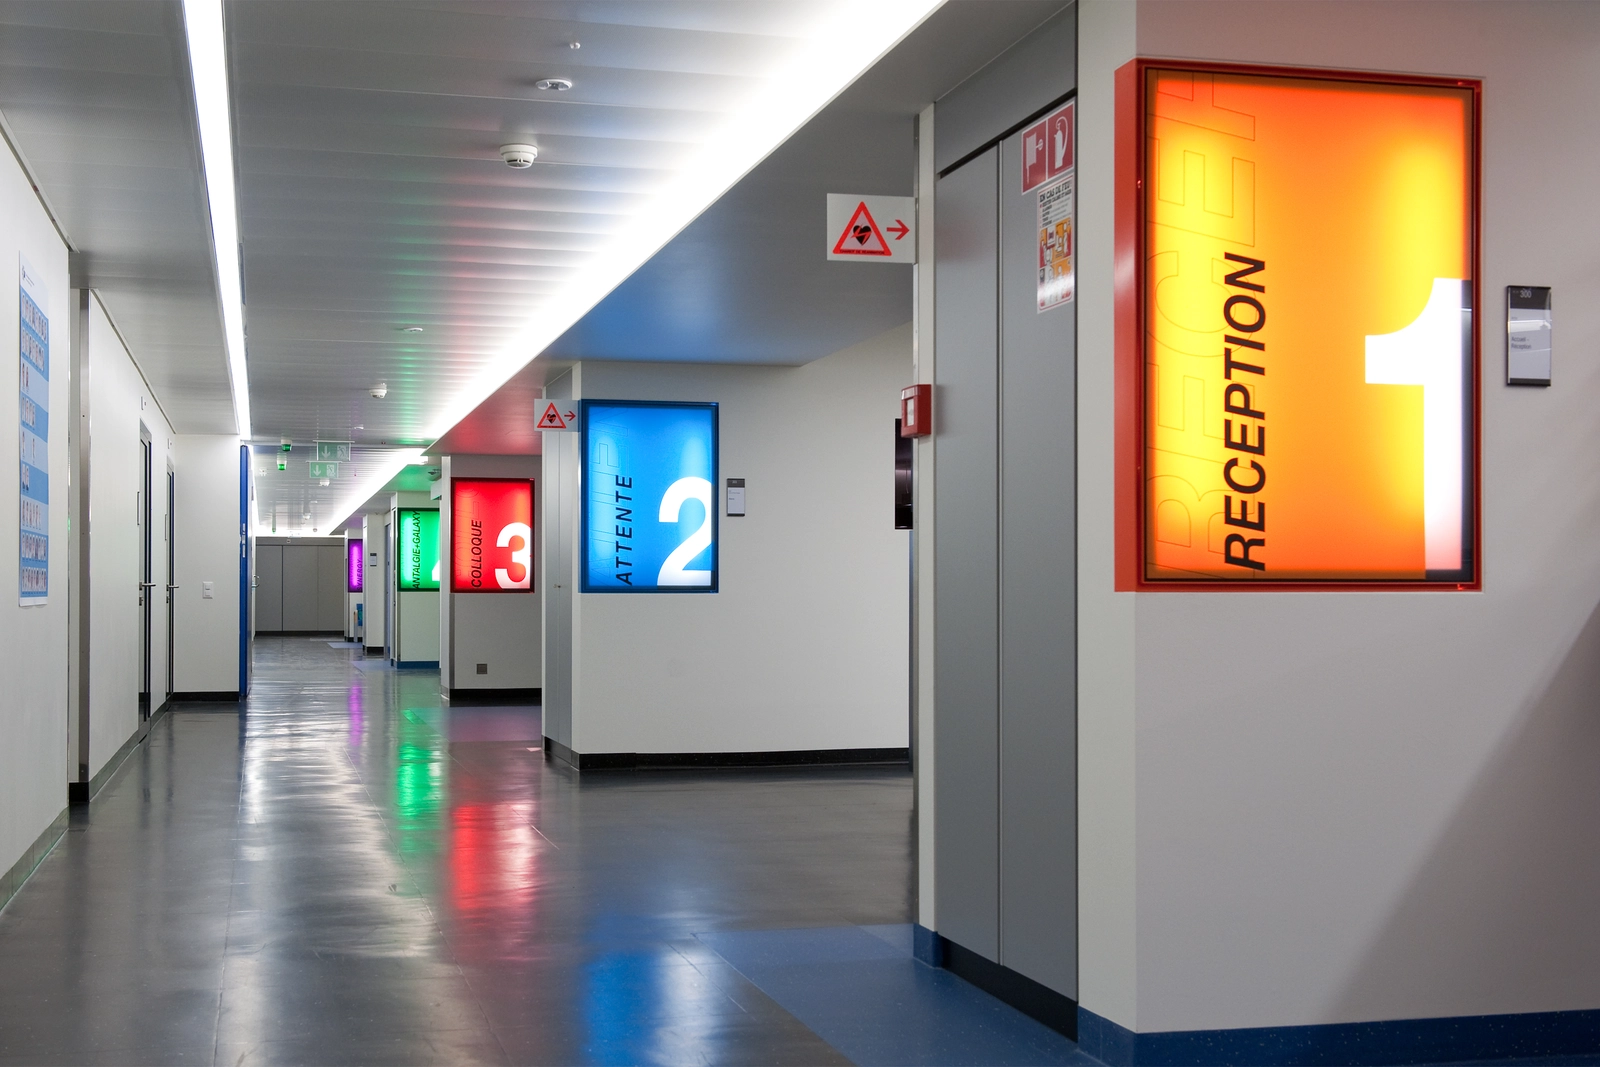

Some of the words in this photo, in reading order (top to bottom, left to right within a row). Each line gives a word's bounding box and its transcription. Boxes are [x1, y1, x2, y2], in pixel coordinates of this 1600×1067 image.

[1519, 290, 1532, 299] 300
[1223, 251, 1266, 571] RECEPTION
[1365, 277, 1474, 580] 1
[471, 520, 482, 588] COLLOQUE
[495, 522, 532, 590] 3
[615, 475, 633, 586] ATTENTE
[656, 476, 715, 590] 2
